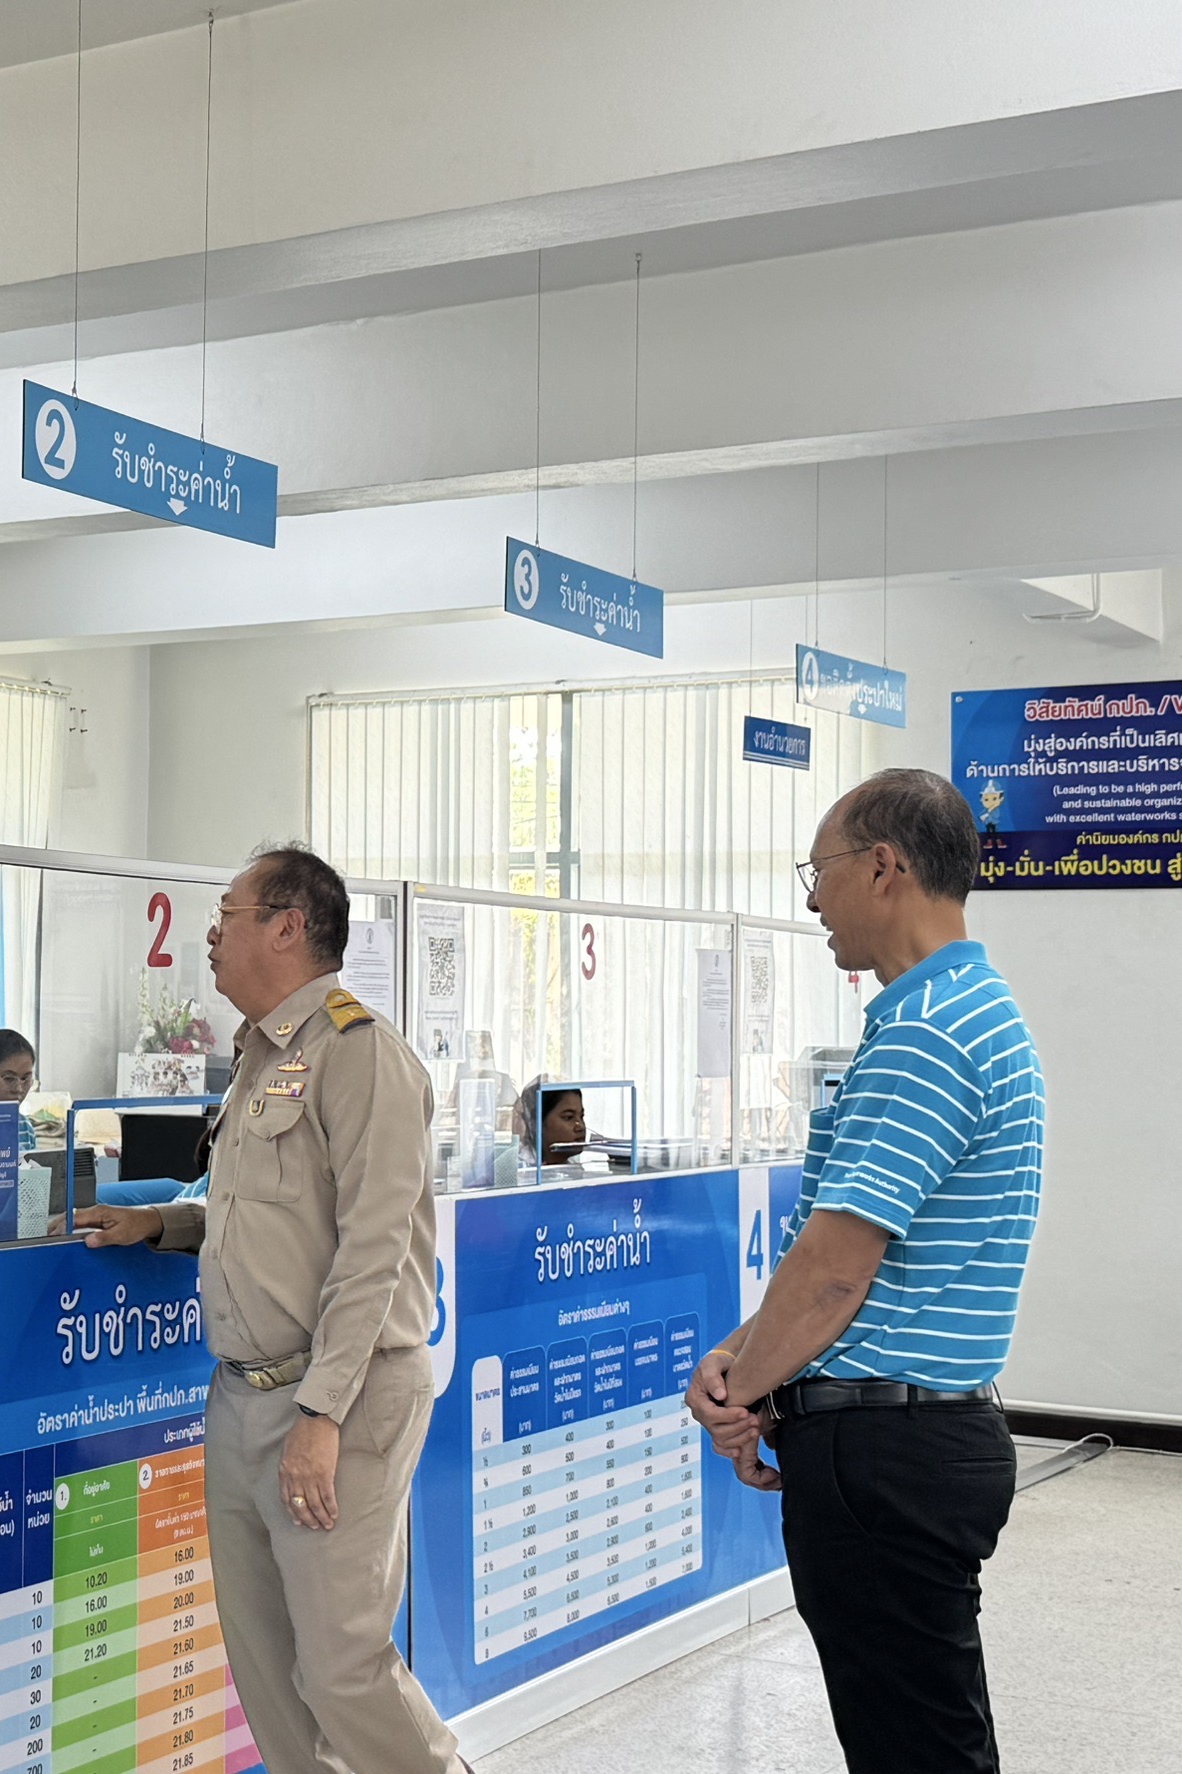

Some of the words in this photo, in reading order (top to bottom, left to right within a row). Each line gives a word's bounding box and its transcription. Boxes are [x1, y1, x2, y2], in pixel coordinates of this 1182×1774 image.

[44, 408, 66, 470] 2
[112, 431, 241, 514] รับชำระค่าน้ำ
[520, 556, 533, 602] 3
[559, 573, 641, 632] รับชำระค่าน้ำ
[804, 657, 814, 694] 4
[1024, 695, 1105, 721] วิสัยทัศน์
[1106, 693, 1156, 718] กปภ.
[1053, 785, 1096, 797] (Leading
[1099, 785, 1109, 794] to
[1111, 784, 1124, 793] be
[1127, 785, 1133, 793] a
[1135, 782, 1158, 794] high
[1062, 799, 1081, 809] and
[1083, 797, 1142, 808] sustainable
[1045, 814, 1067, 823] with
[1069, 812, 1114, 823] excellent
[1117, 811, 1176, 822] waterworks
[1076, 830, 1159, 846] ค่านิยมองค์กร
[147, 892, 173, 967] 2
[581, 923, 596, 980] 3
[534, 1198, 650, 1283] รับชำระค่าน้ำ
[746, 1209, 763, 1280] 4
[37, 1395, 134, 1434] อัตราค่าน้ำประปา
[26, 1489, 52, 1505] จำนวน
[27, 1511, 50, 1528] หน่วย
[173, 1546, 194, 1563] 16.00
[85, 1571, 108, 1589] 10.20
[173, 1569, 194, 1586] 19.00
[32, 1590, 43, 1605] 10
[85, 1595, 108, 1613] 16.00
[173, 1592, 194, 1609] 20.00
[31, 1615, 43, 1630] 10
[85, 1619, 108, 1637] 19.00
[173, 1614, 194, 1632] 21.50
[31, 1640, 42, 1655] 10
[85, 1643, 108, 1662] 21.20
[173, 1637, 194, 1655] 21.60
[30, 1664, 42, 1680] 20
[173, 1660, 194, 1678] 21.65
[30, 1689, 41, 1705] 30
[173, 1683, 194, 1701] 21.70
[30, 1714, 41, 1730] 20
[173, 1706, 194, 1724] 21.75
[27, 1738, 43, 1756] 200
[173, 1729, 194, 1748] 21.80
[173, 1752, 194, 1772] 21.85
